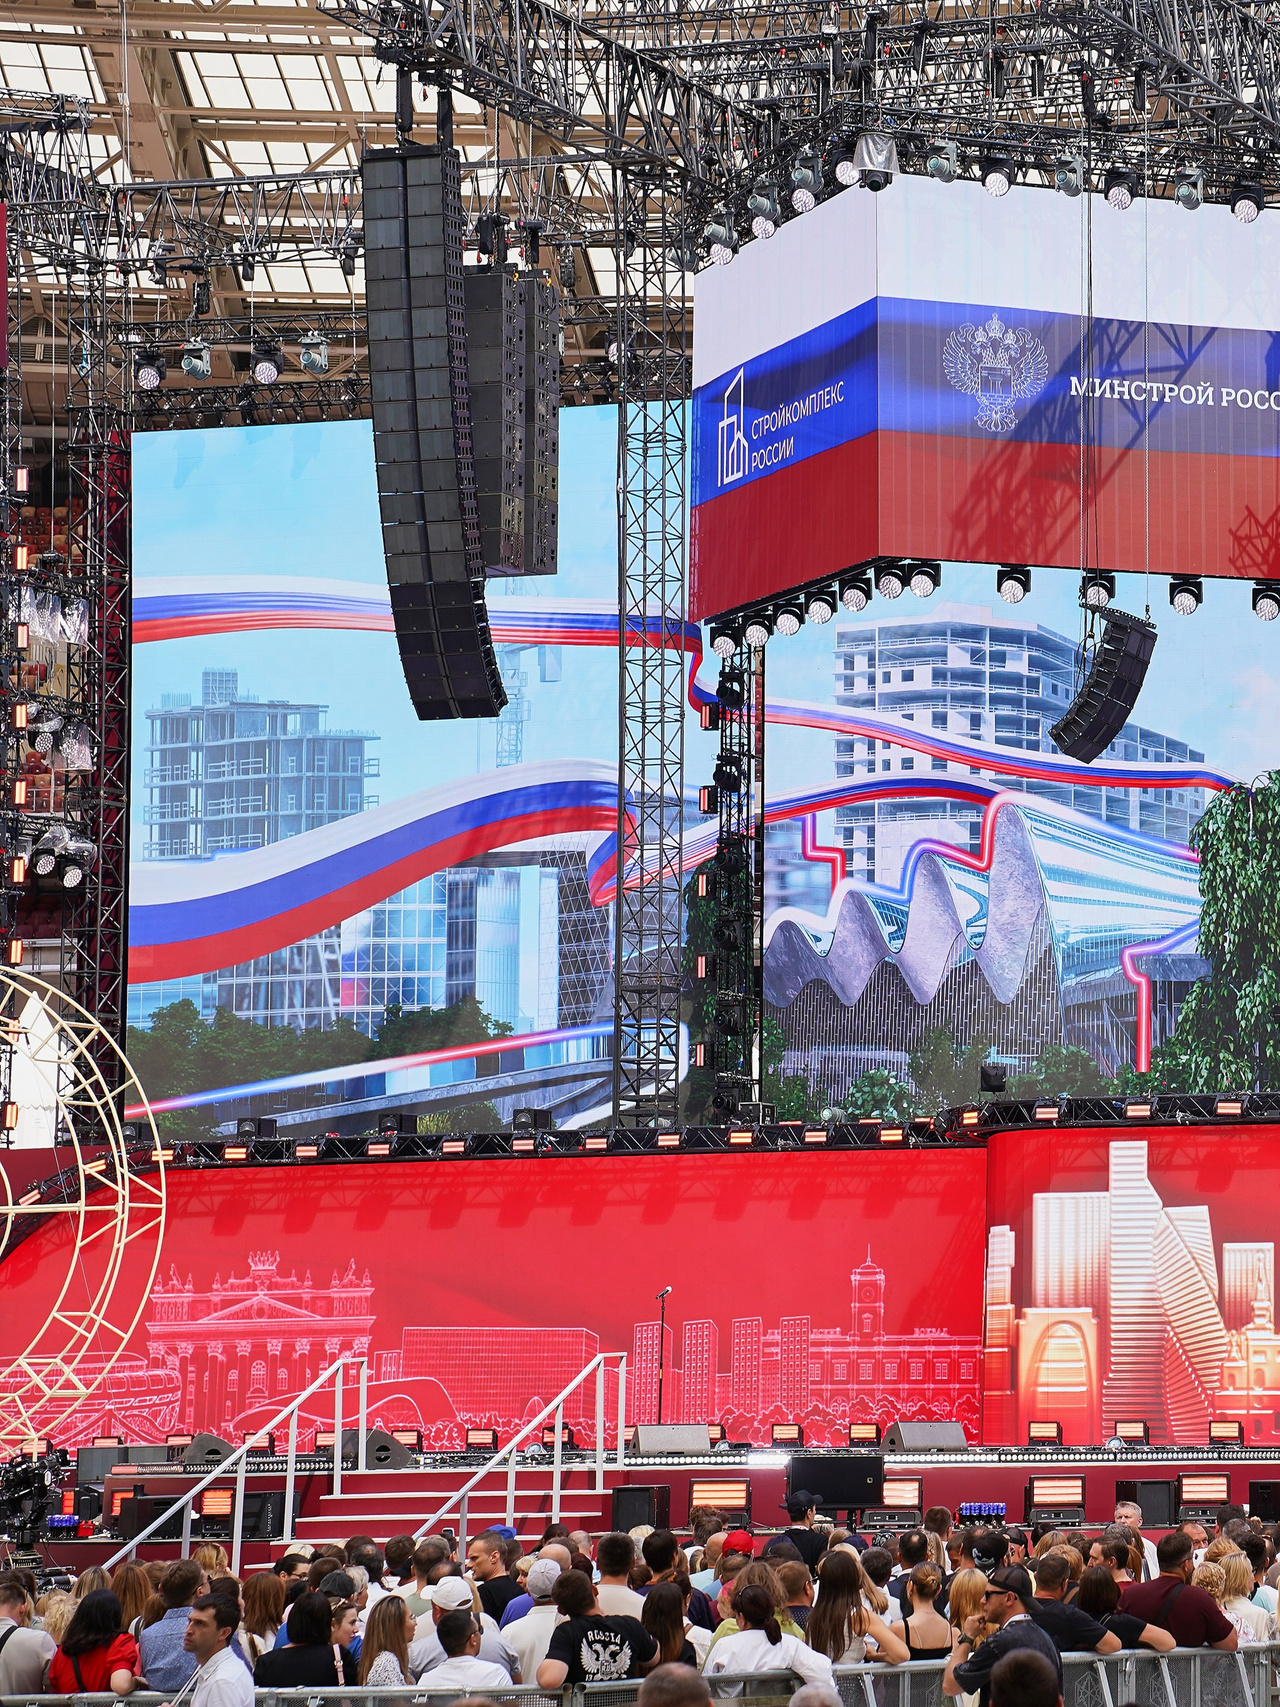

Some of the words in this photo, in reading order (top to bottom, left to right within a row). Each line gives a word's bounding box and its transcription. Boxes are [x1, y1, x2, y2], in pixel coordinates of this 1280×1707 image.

[1070, 376, 1214, 406] МИНСТРОЙ
[751, 381, 845, 440] СТРОЙКОМПЛЕКС
[751, 436, 794, 473] РОССИИ
